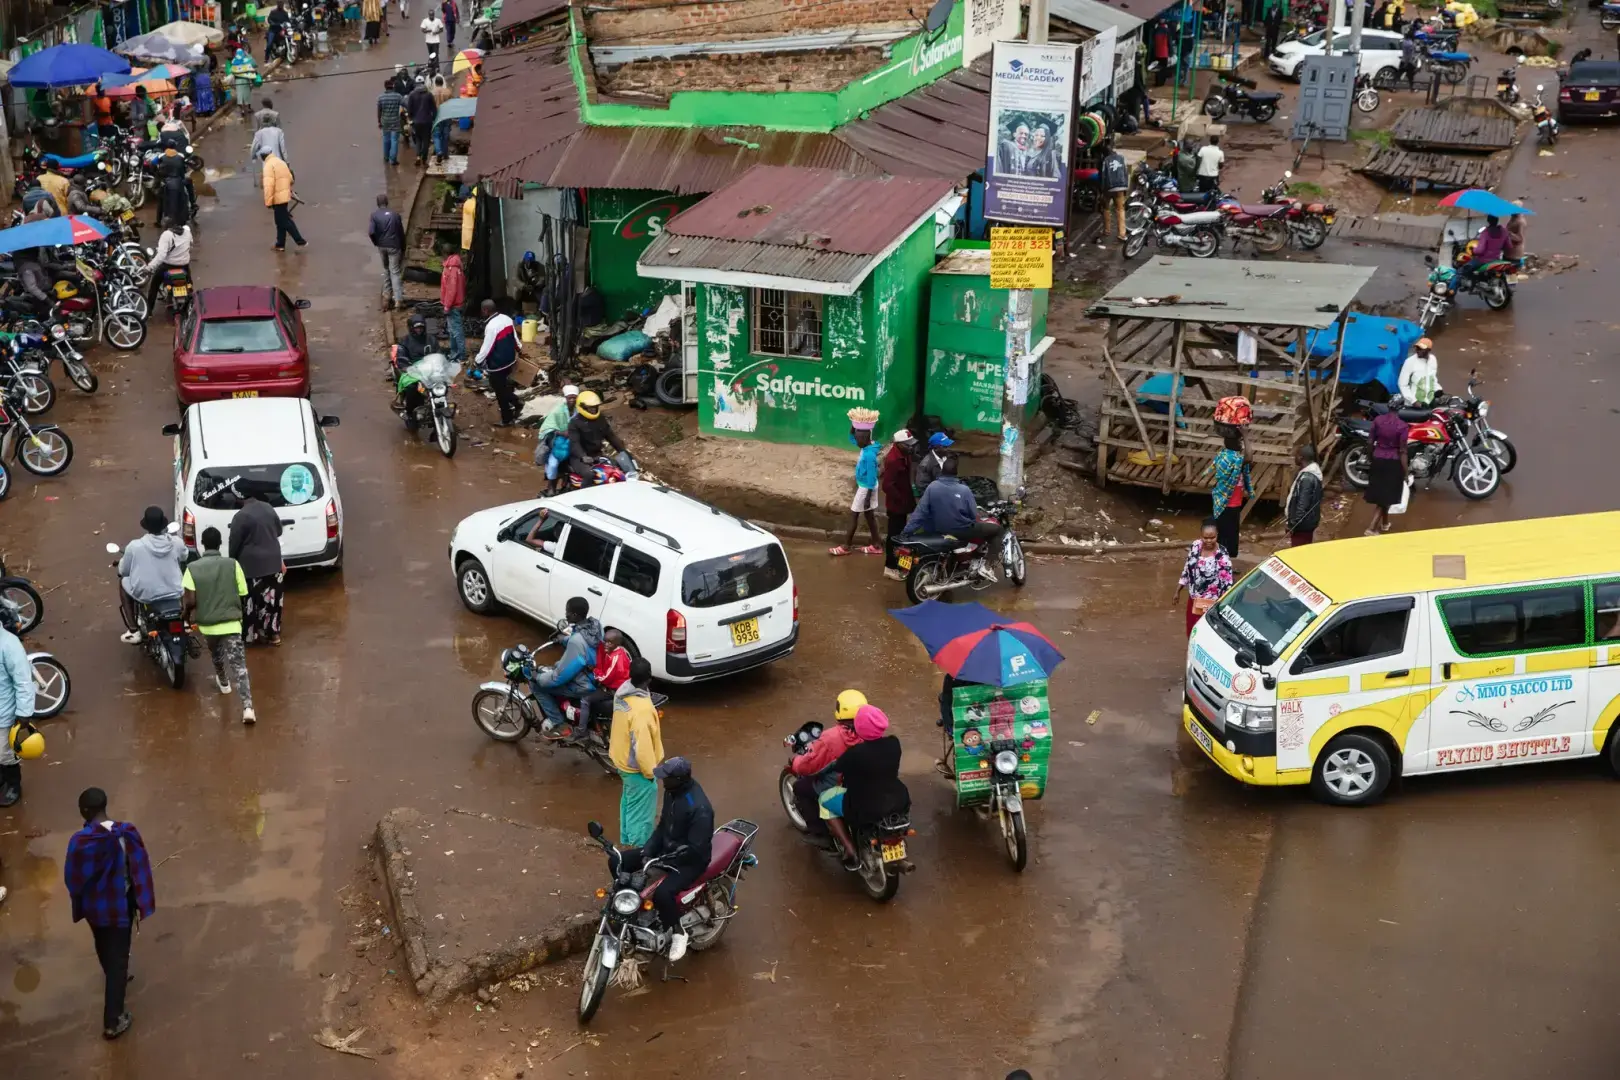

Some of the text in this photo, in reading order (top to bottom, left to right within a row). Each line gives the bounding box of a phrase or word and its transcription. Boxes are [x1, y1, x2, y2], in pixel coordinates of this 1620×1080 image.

[920, 34, 962, 72] Safaricom
[996, 72, 1064, 83] MEDIA ACADEMY
[1024, 67, 1054, 75] AFRICA
[647, 216, 661, 236] S
[991, 240, 1051, 249] 0711 281 323
[756, 373, 865, 400] Safaricom
[1297, 582, 1313, 596] BUT
[1308, 592, 1325, 606] GOD
[734, 621, 751, 635] KDB
[736, 630, 759, 644] 993G
[1220, 670, 1232, 689] LTD
[1511, 680, 1548, 696] SACCO
[1551, 678, 1573, 692] LTD
[1280, 700, 1303, 714] WALK
[1436, 736, 1571, 766] FLYING SHUTTLE
